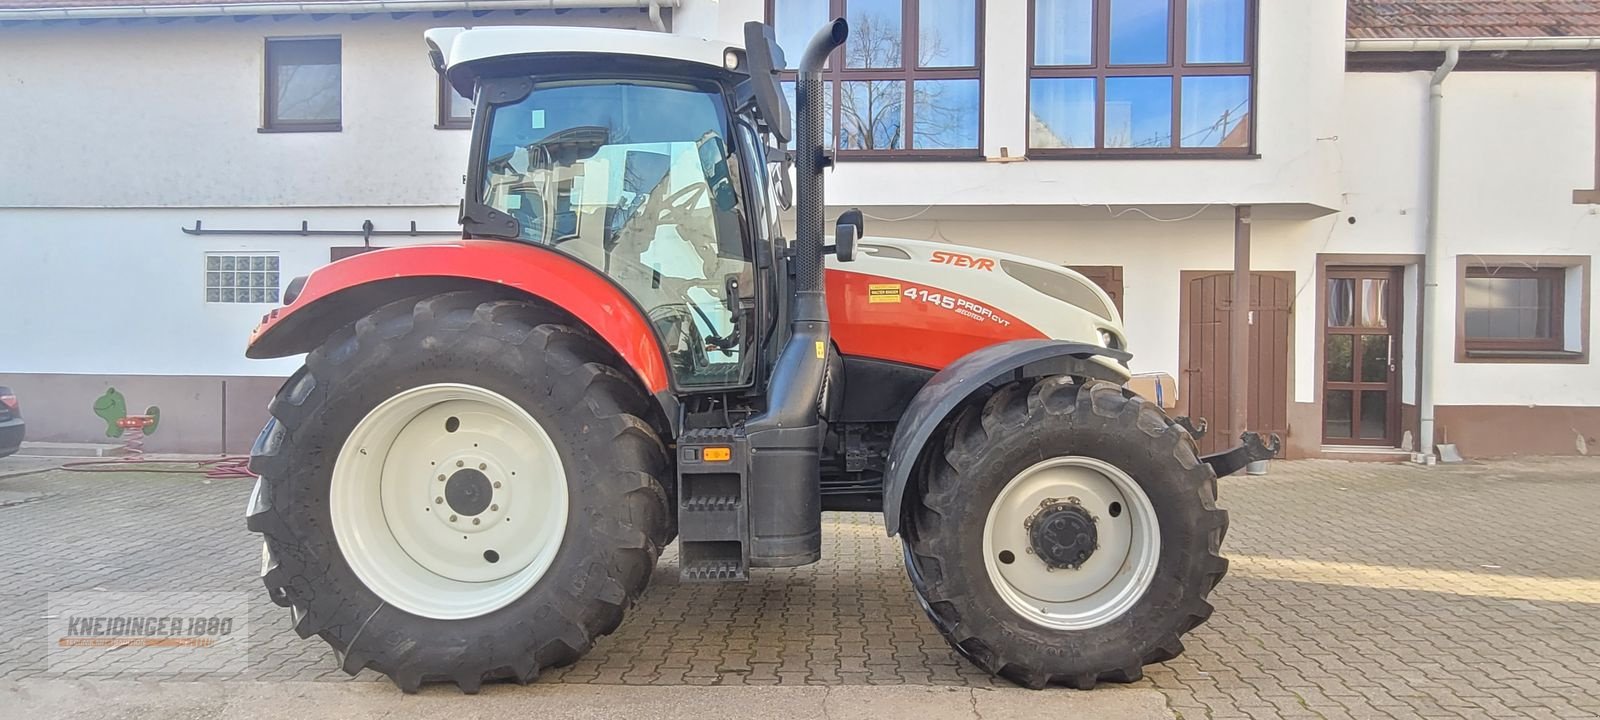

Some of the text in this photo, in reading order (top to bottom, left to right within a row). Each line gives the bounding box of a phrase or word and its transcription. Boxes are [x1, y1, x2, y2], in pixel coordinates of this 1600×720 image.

[929, 251, 995, 273] STEYR
[903, 287, 1011, 327] 4145 PROFI CVT
